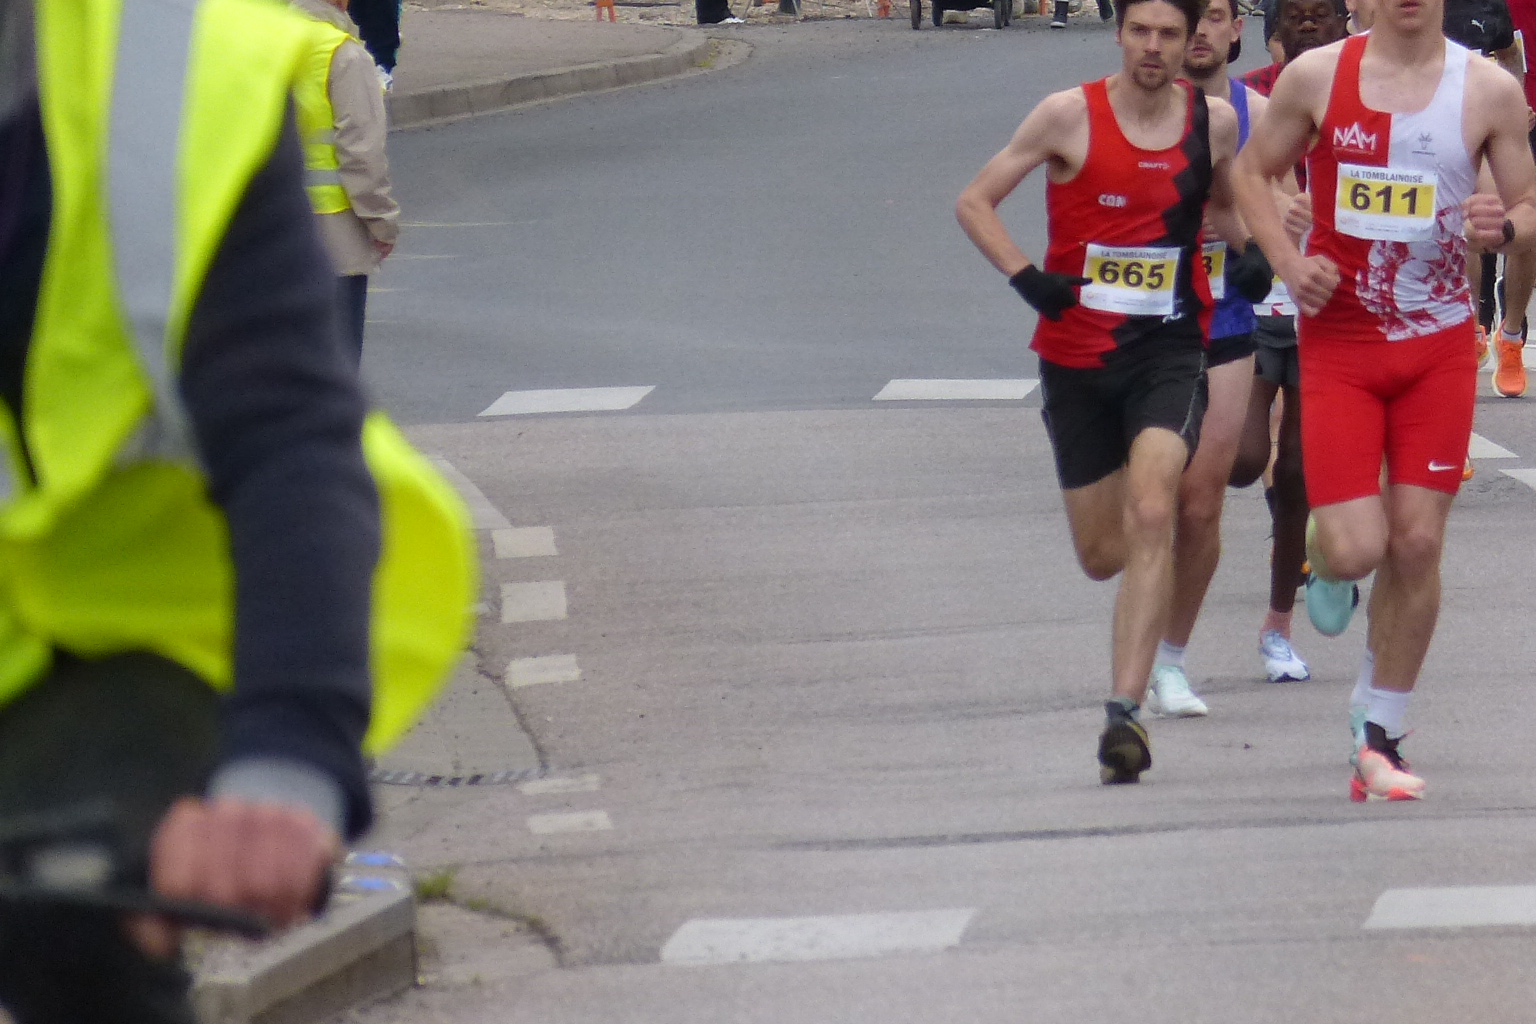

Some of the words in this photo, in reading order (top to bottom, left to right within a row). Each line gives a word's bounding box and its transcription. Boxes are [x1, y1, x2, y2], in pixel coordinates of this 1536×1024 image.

[1333, 122, 1376, 150] NAM
[1350, 170, 1360, 178] LA
[1362, 171, 1424, 183] TOMBLAINOISE
[1350, 182, 1418, 215] 611
[1099, 260, 1165, 290] 665
